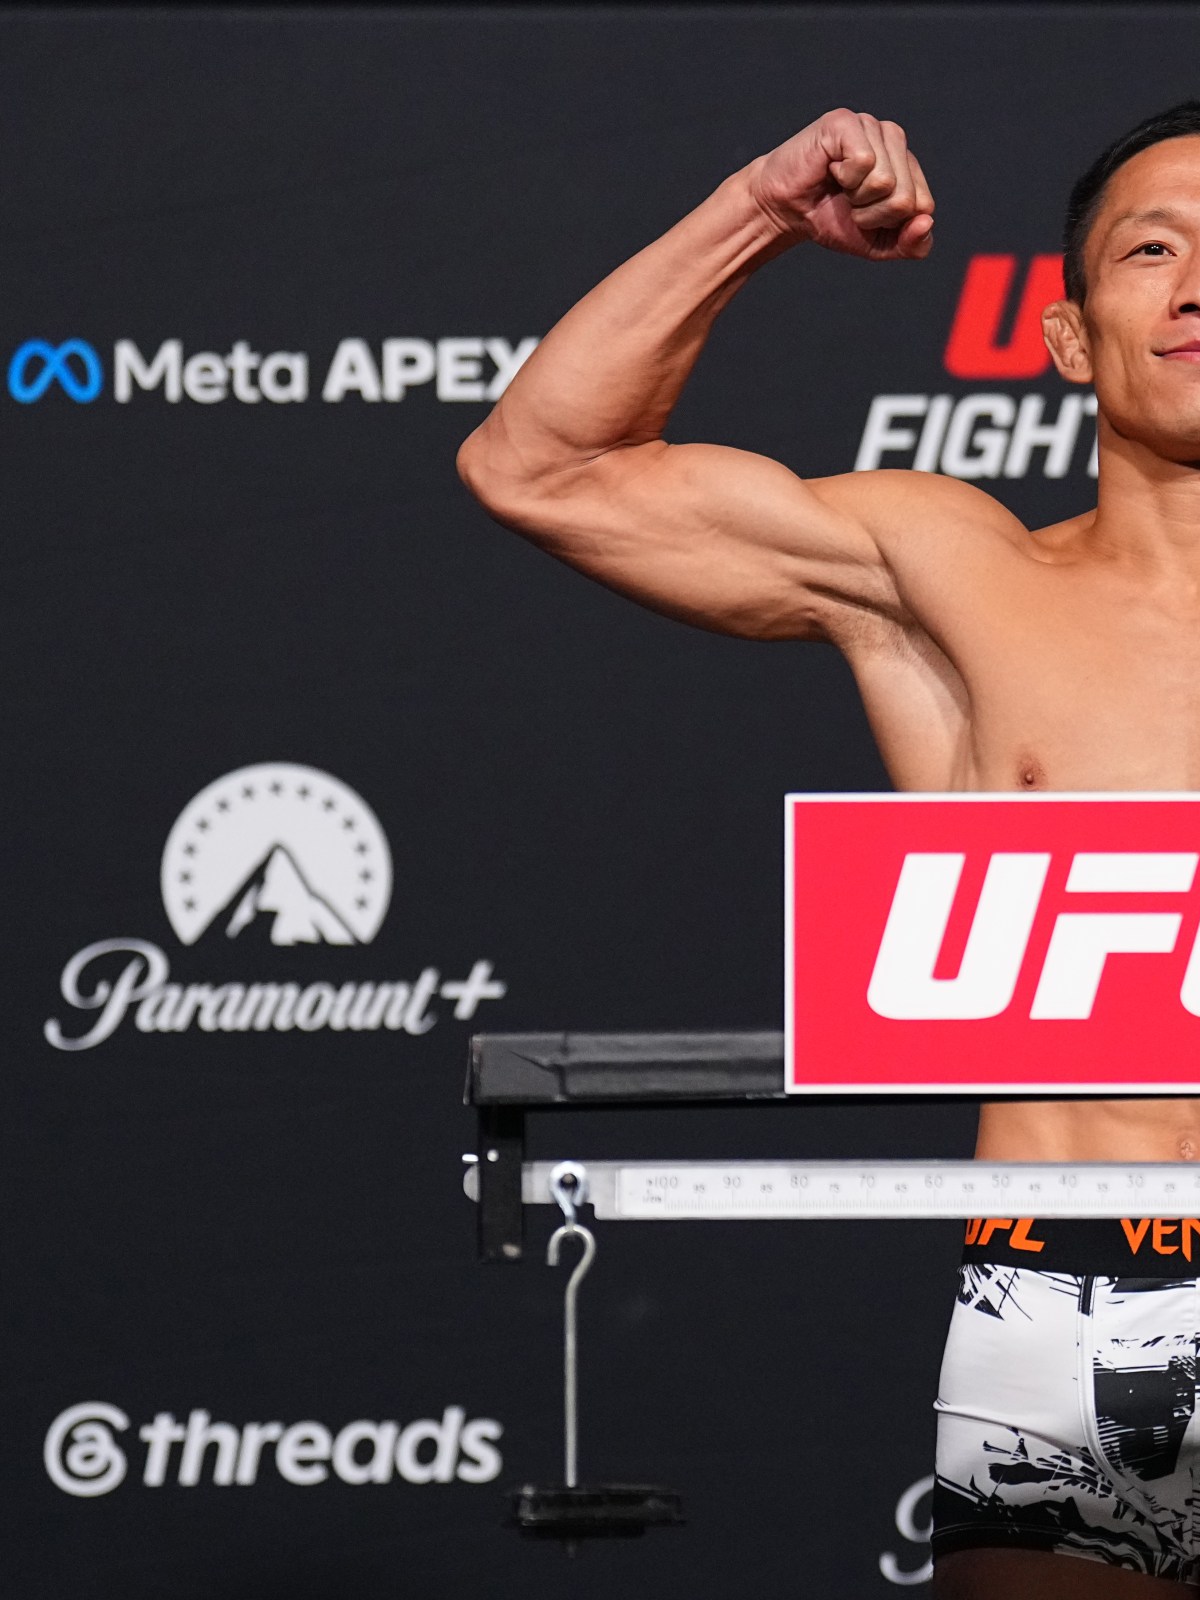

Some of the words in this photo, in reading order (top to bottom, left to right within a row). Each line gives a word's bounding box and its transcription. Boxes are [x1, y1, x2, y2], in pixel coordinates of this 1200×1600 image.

[113, 339, 309, 404] Meta
[322, 337, 540, 404] APEX
[44, 936, 507, 1051] Paramount+
[139, 1405, 503, 1487] threads
